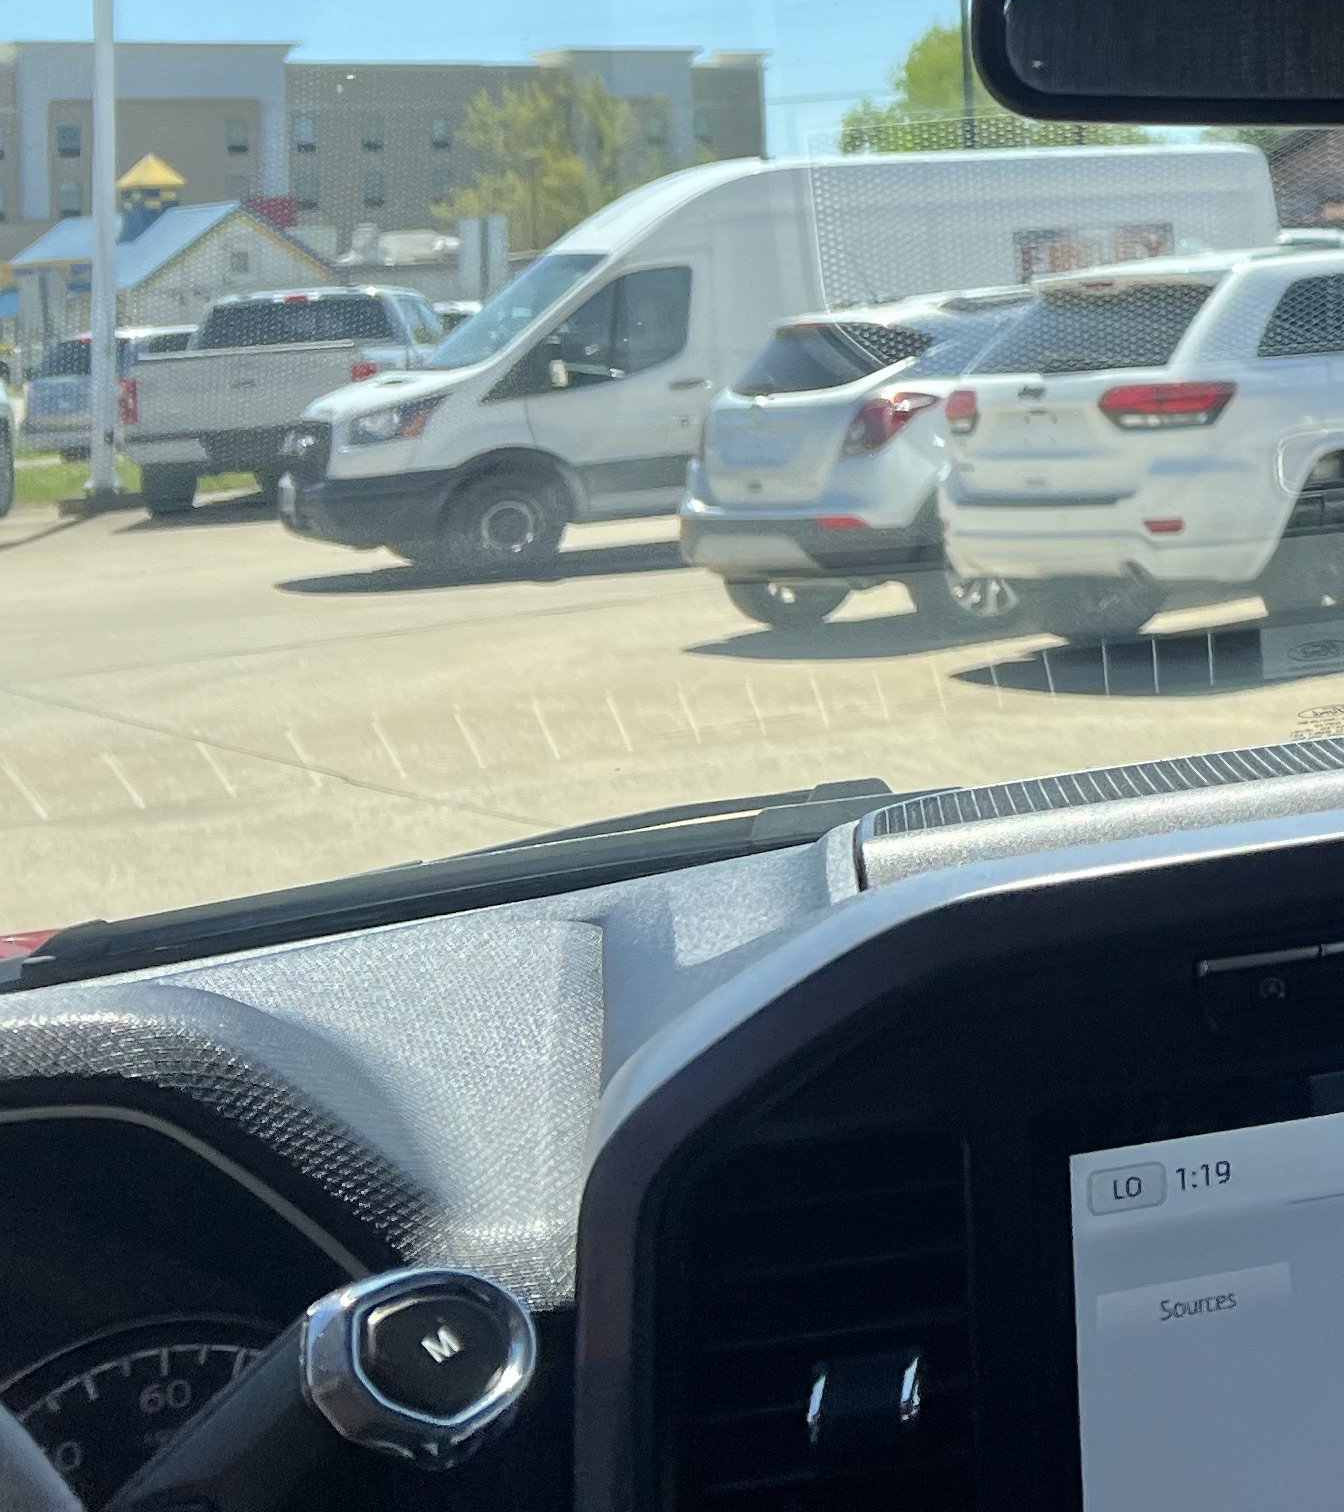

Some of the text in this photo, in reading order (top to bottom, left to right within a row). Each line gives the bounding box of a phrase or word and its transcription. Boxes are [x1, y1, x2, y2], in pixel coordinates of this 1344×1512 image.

[1112, 1176, 1143, 1201] LO
[1175, 1160, 1232, 1191] 1:19
[1159, 1292, 1238, 1321] Sources
